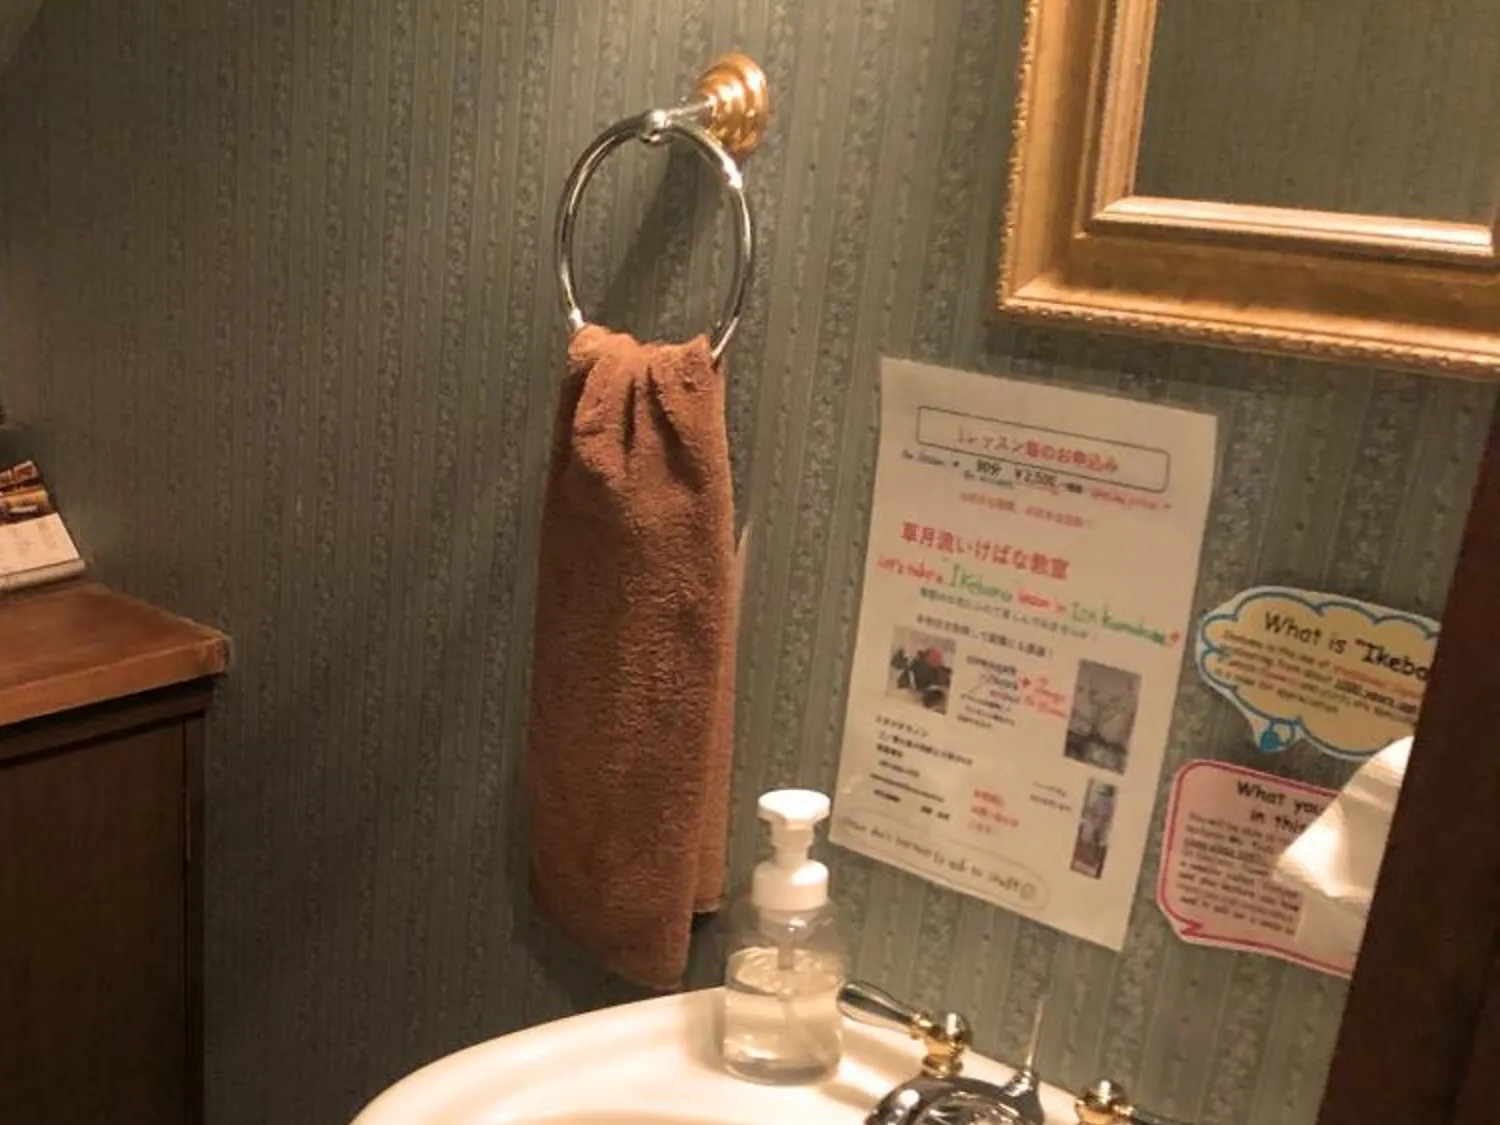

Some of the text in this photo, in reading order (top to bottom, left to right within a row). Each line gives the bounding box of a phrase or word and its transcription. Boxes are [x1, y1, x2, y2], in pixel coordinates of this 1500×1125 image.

[1263, 611, 1322, 648] What
[1328, 632, 1347, 654] is
[1237, 780, 1287, 806] What
